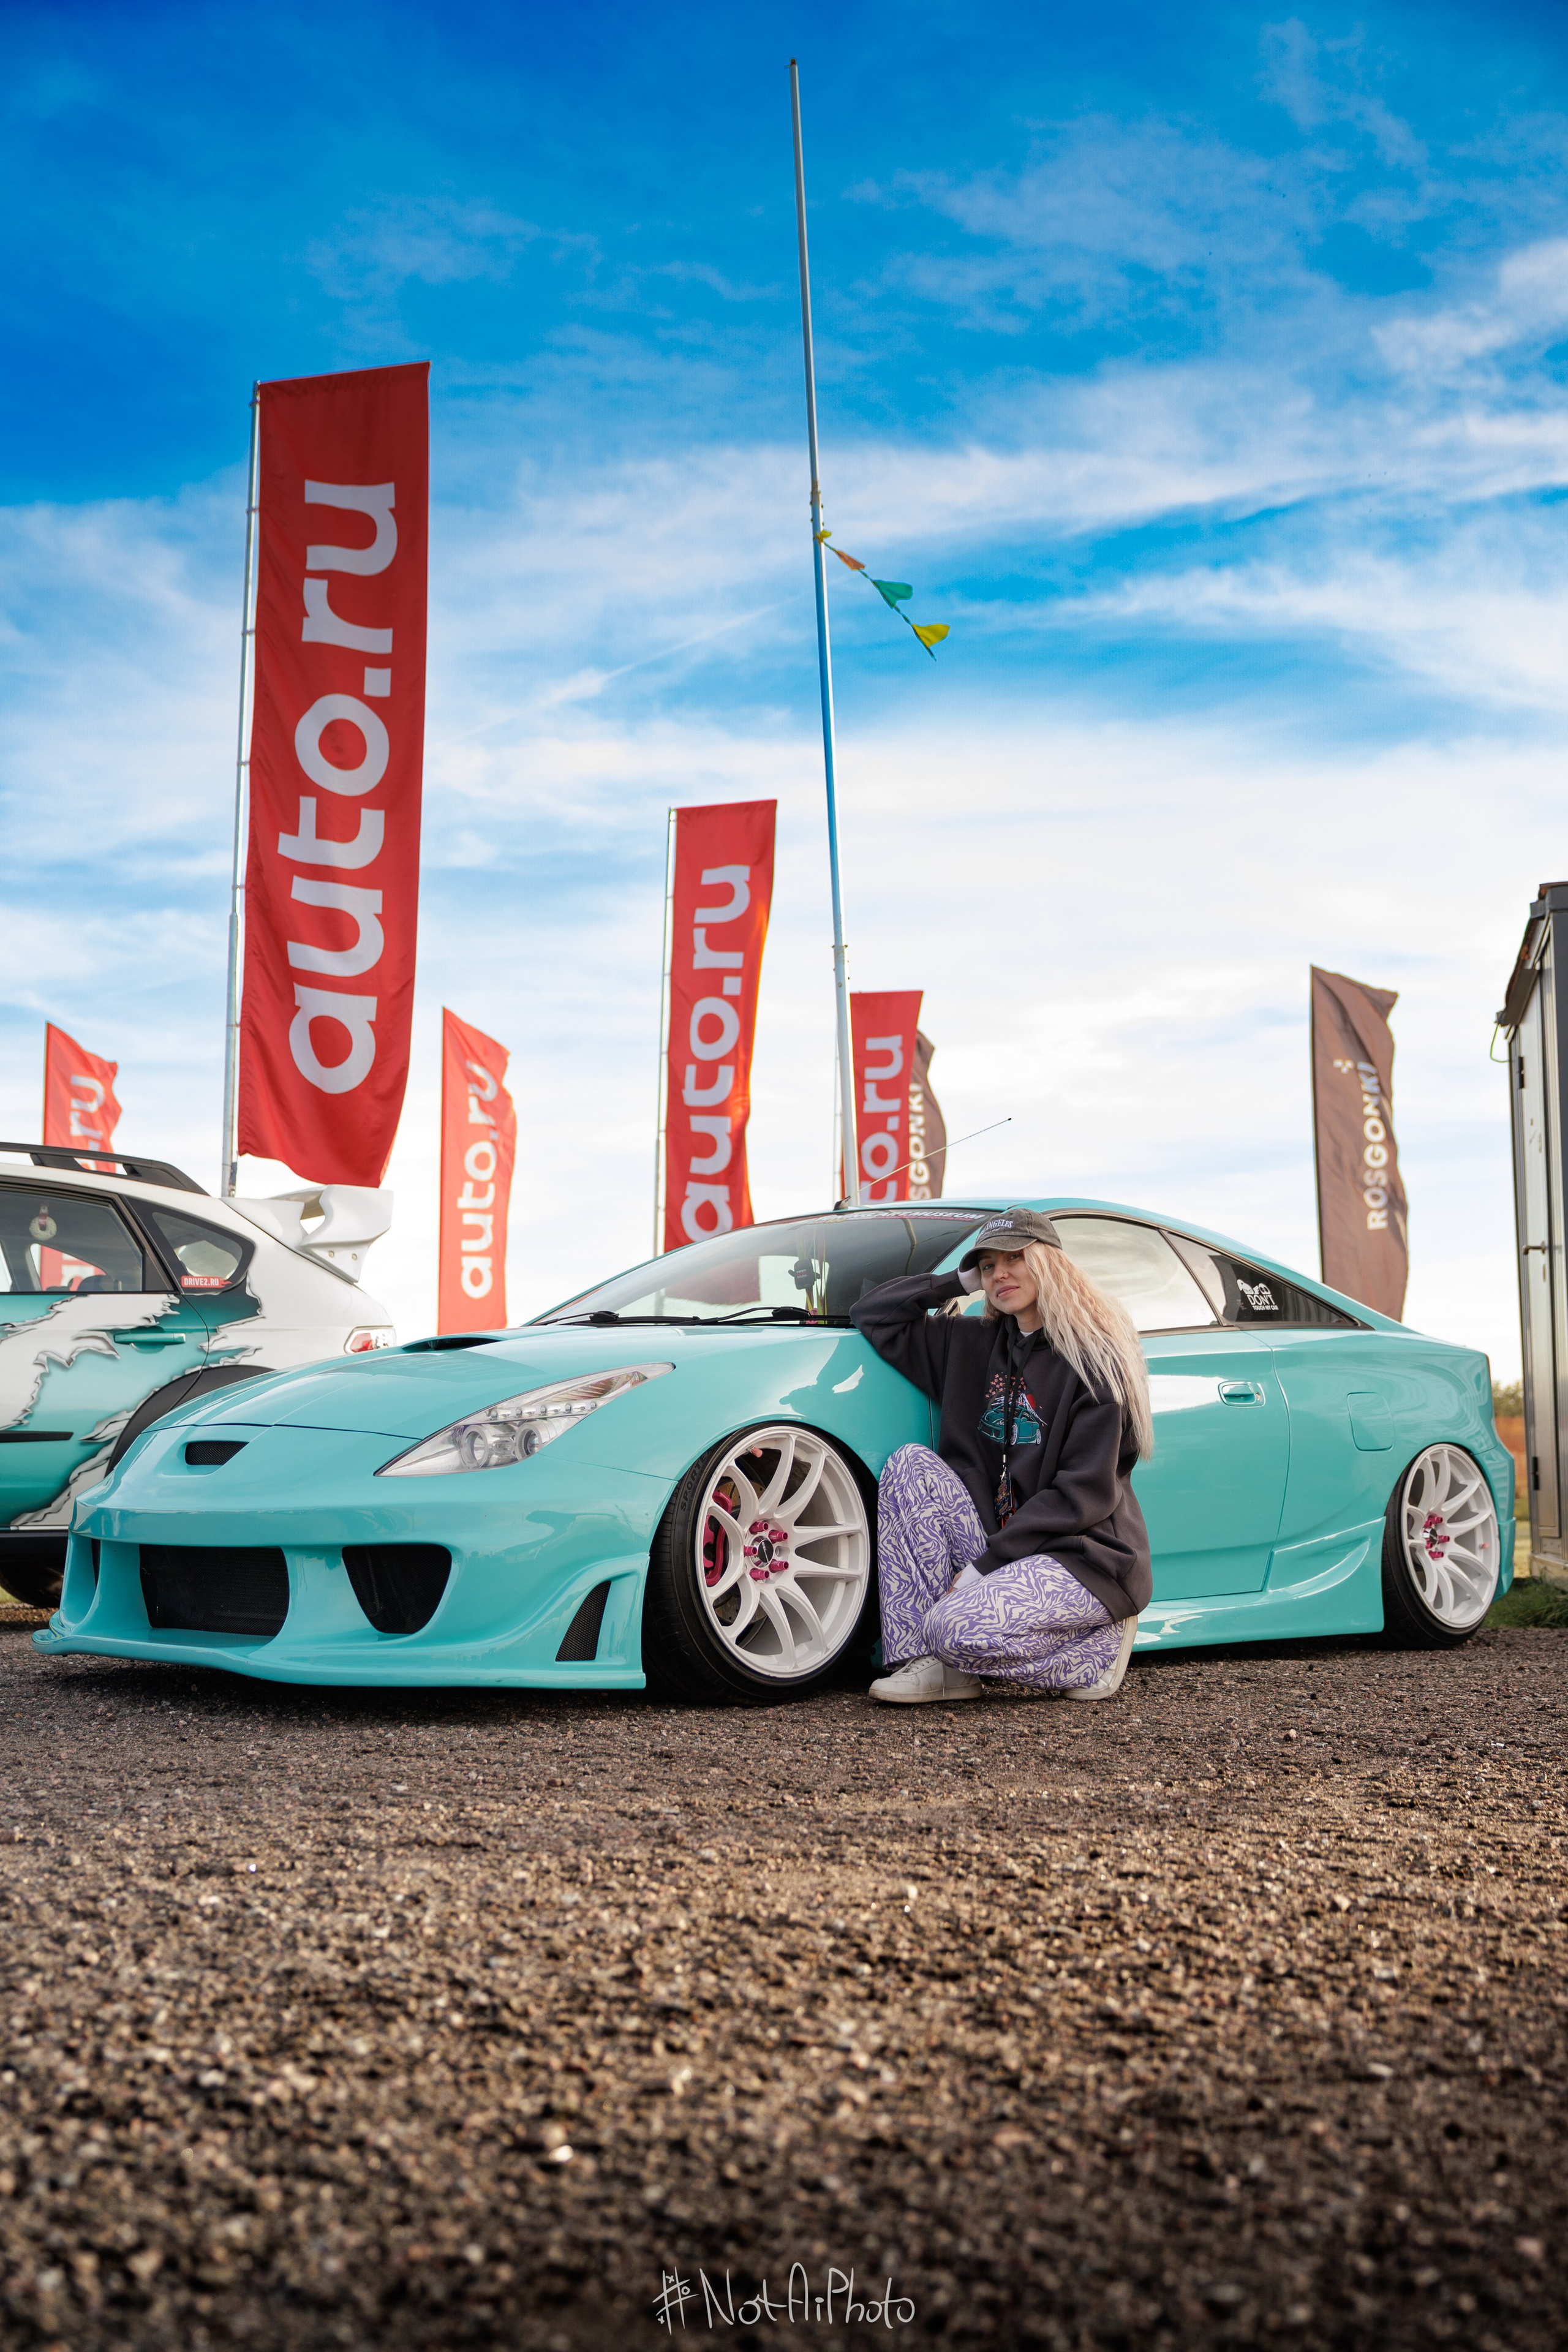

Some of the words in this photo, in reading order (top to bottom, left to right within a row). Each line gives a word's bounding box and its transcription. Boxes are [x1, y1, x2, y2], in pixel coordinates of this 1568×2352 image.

[277, 479, 398, 1095] auto.ru
[680, 864, 751, 1242] auto.ru
[858, 1035, 903, 1205] to.ru
[456, 1060, 499, 1299] auto.ru
[908, 1082, 932, 1200] SGONKI
[984, 1219, 1013, 1231] ANGELES
[1357, 1061, 1389, 1231] ROSGONKI
[184, 1277, 219, 1286] DRIVE2.RU
[1246, 1294, 1275, 1305] DON'T
